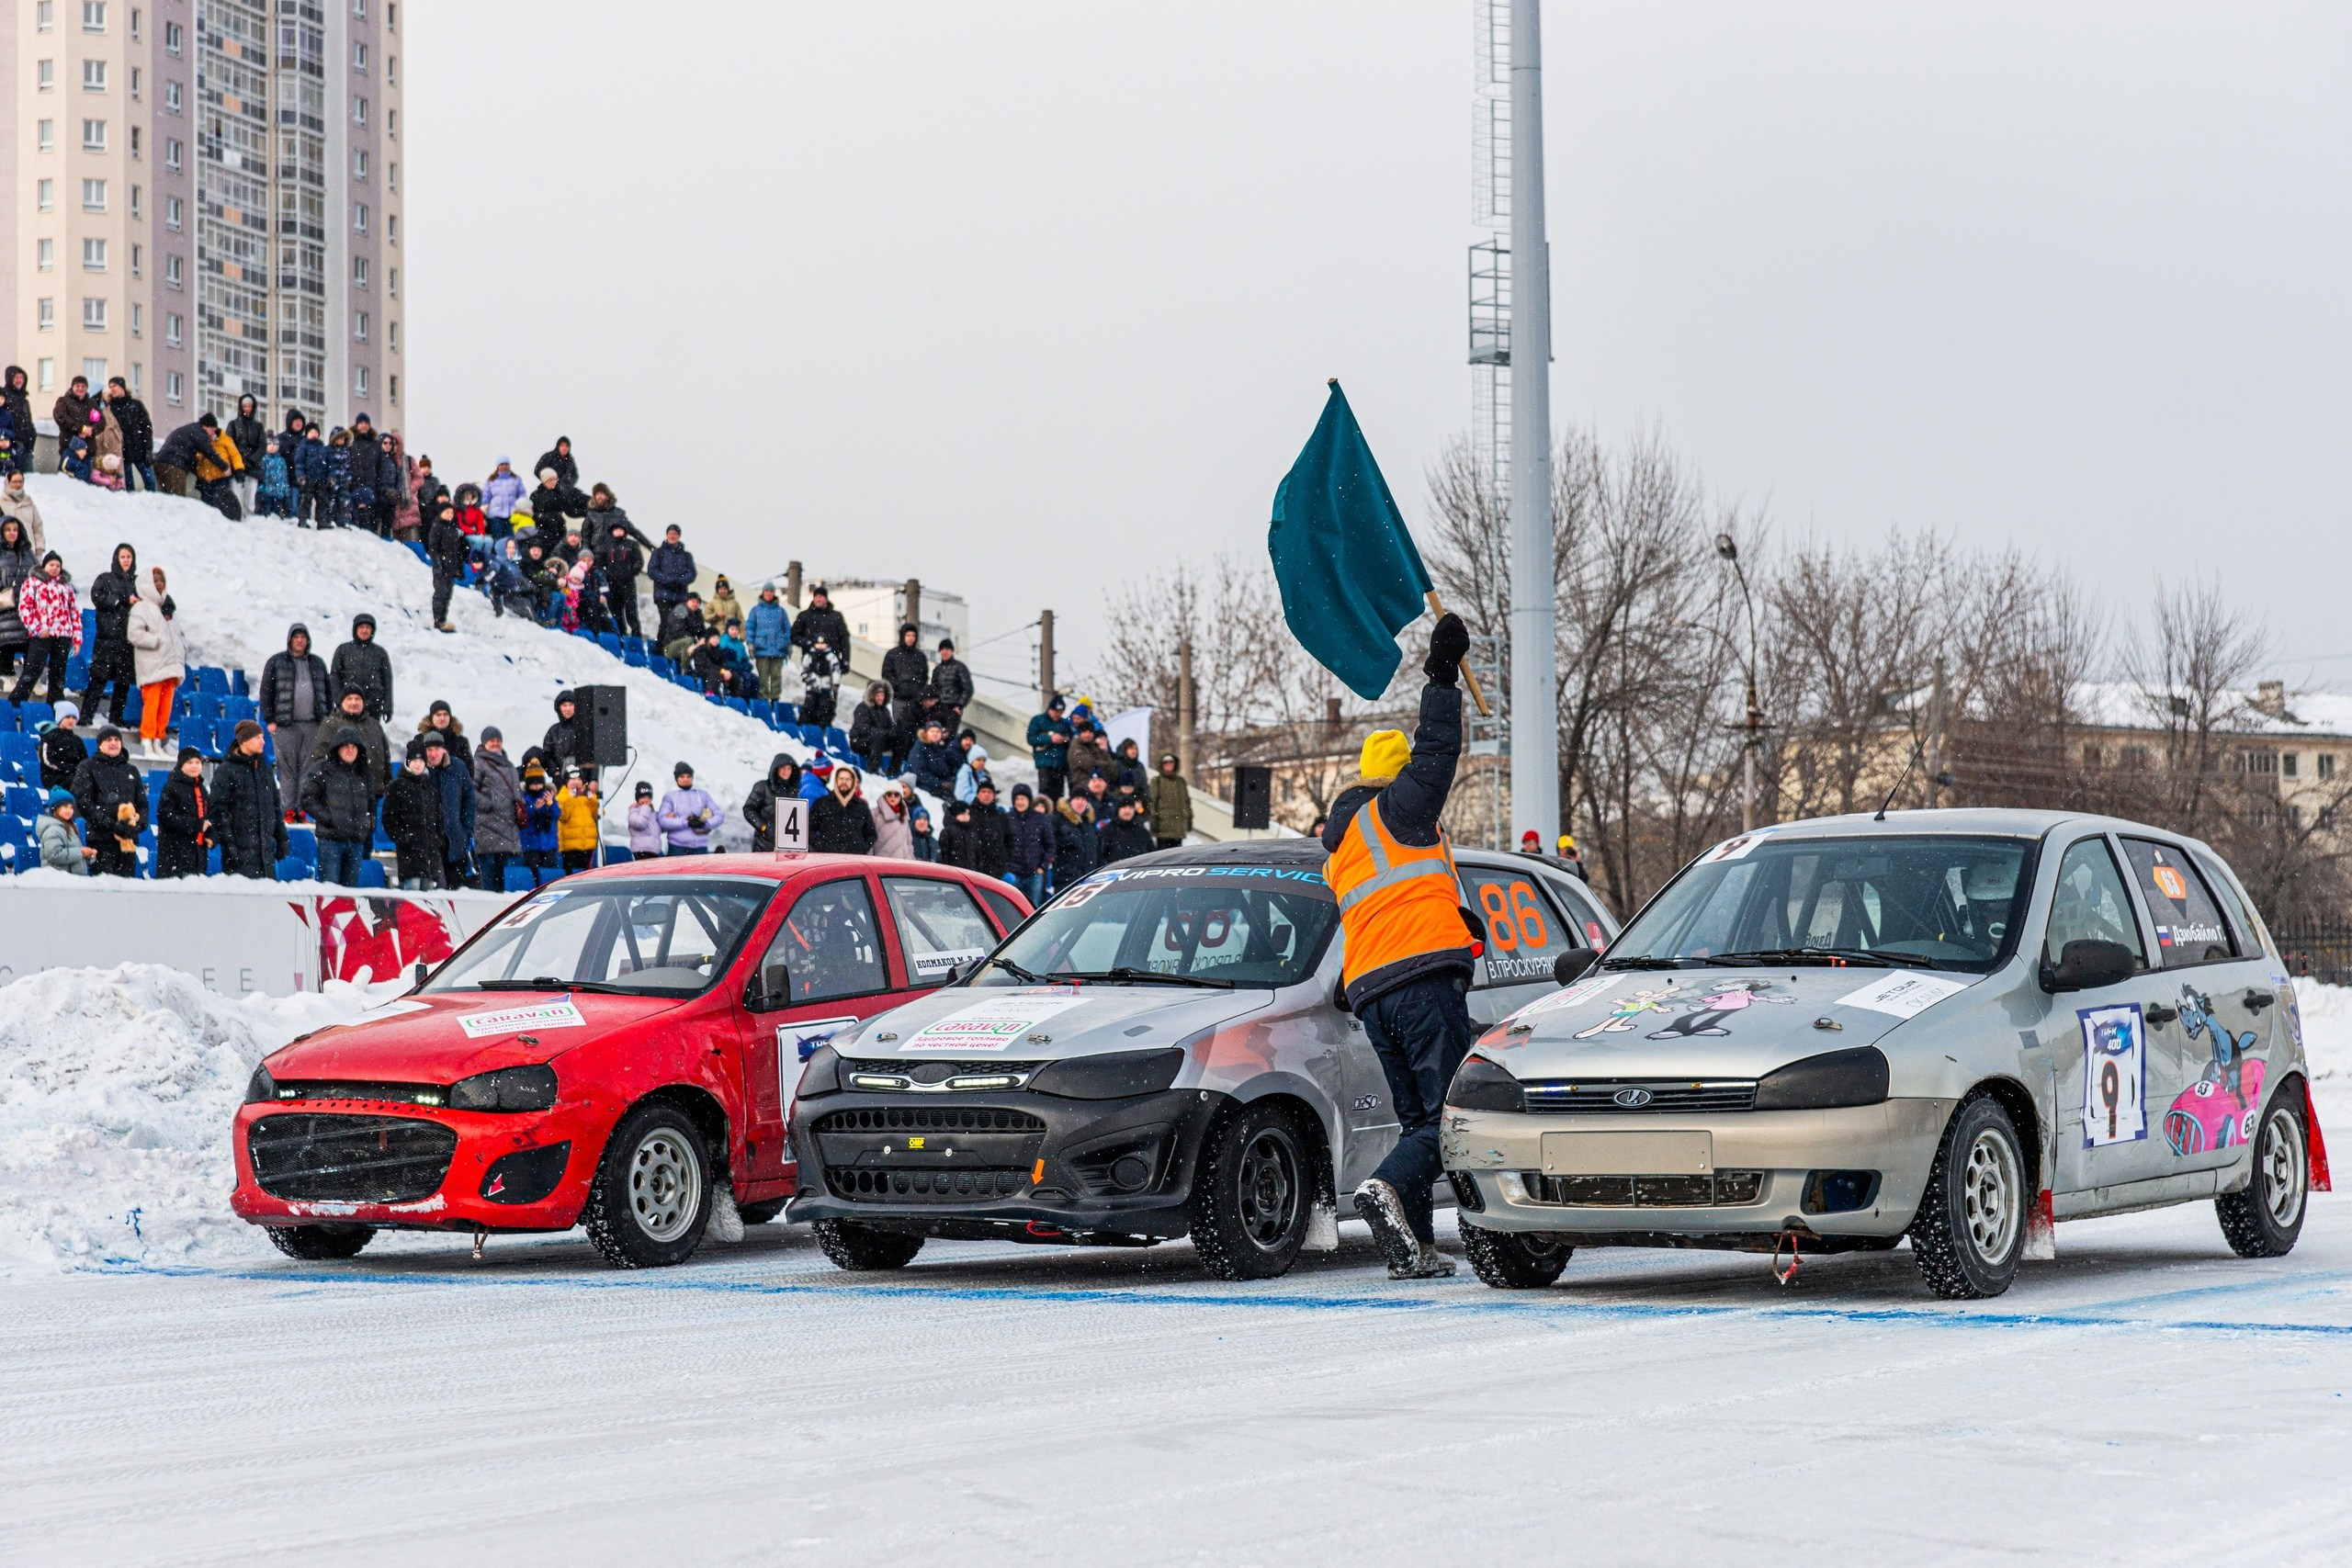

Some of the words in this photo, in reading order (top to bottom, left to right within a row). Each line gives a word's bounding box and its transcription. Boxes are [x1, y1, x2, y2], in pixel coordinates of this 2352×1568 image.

[785, 807, 799, 842] 4
[1712, 836, 1753, 861] 9
[1205, 867, 1329, 886] SERVIC
[2160, 870, 2181, 896] 63
[1050, 883, 1104, 909] 15
[1479, 881, 1548, 952] 86
[2172, 923, 2216, 946] Дзюбайло
[2107, 1038, 2122, 1051] 400
[2101, 1059, 2119, 1139] 9
[2197, 1082, 2210, 1096] 63
